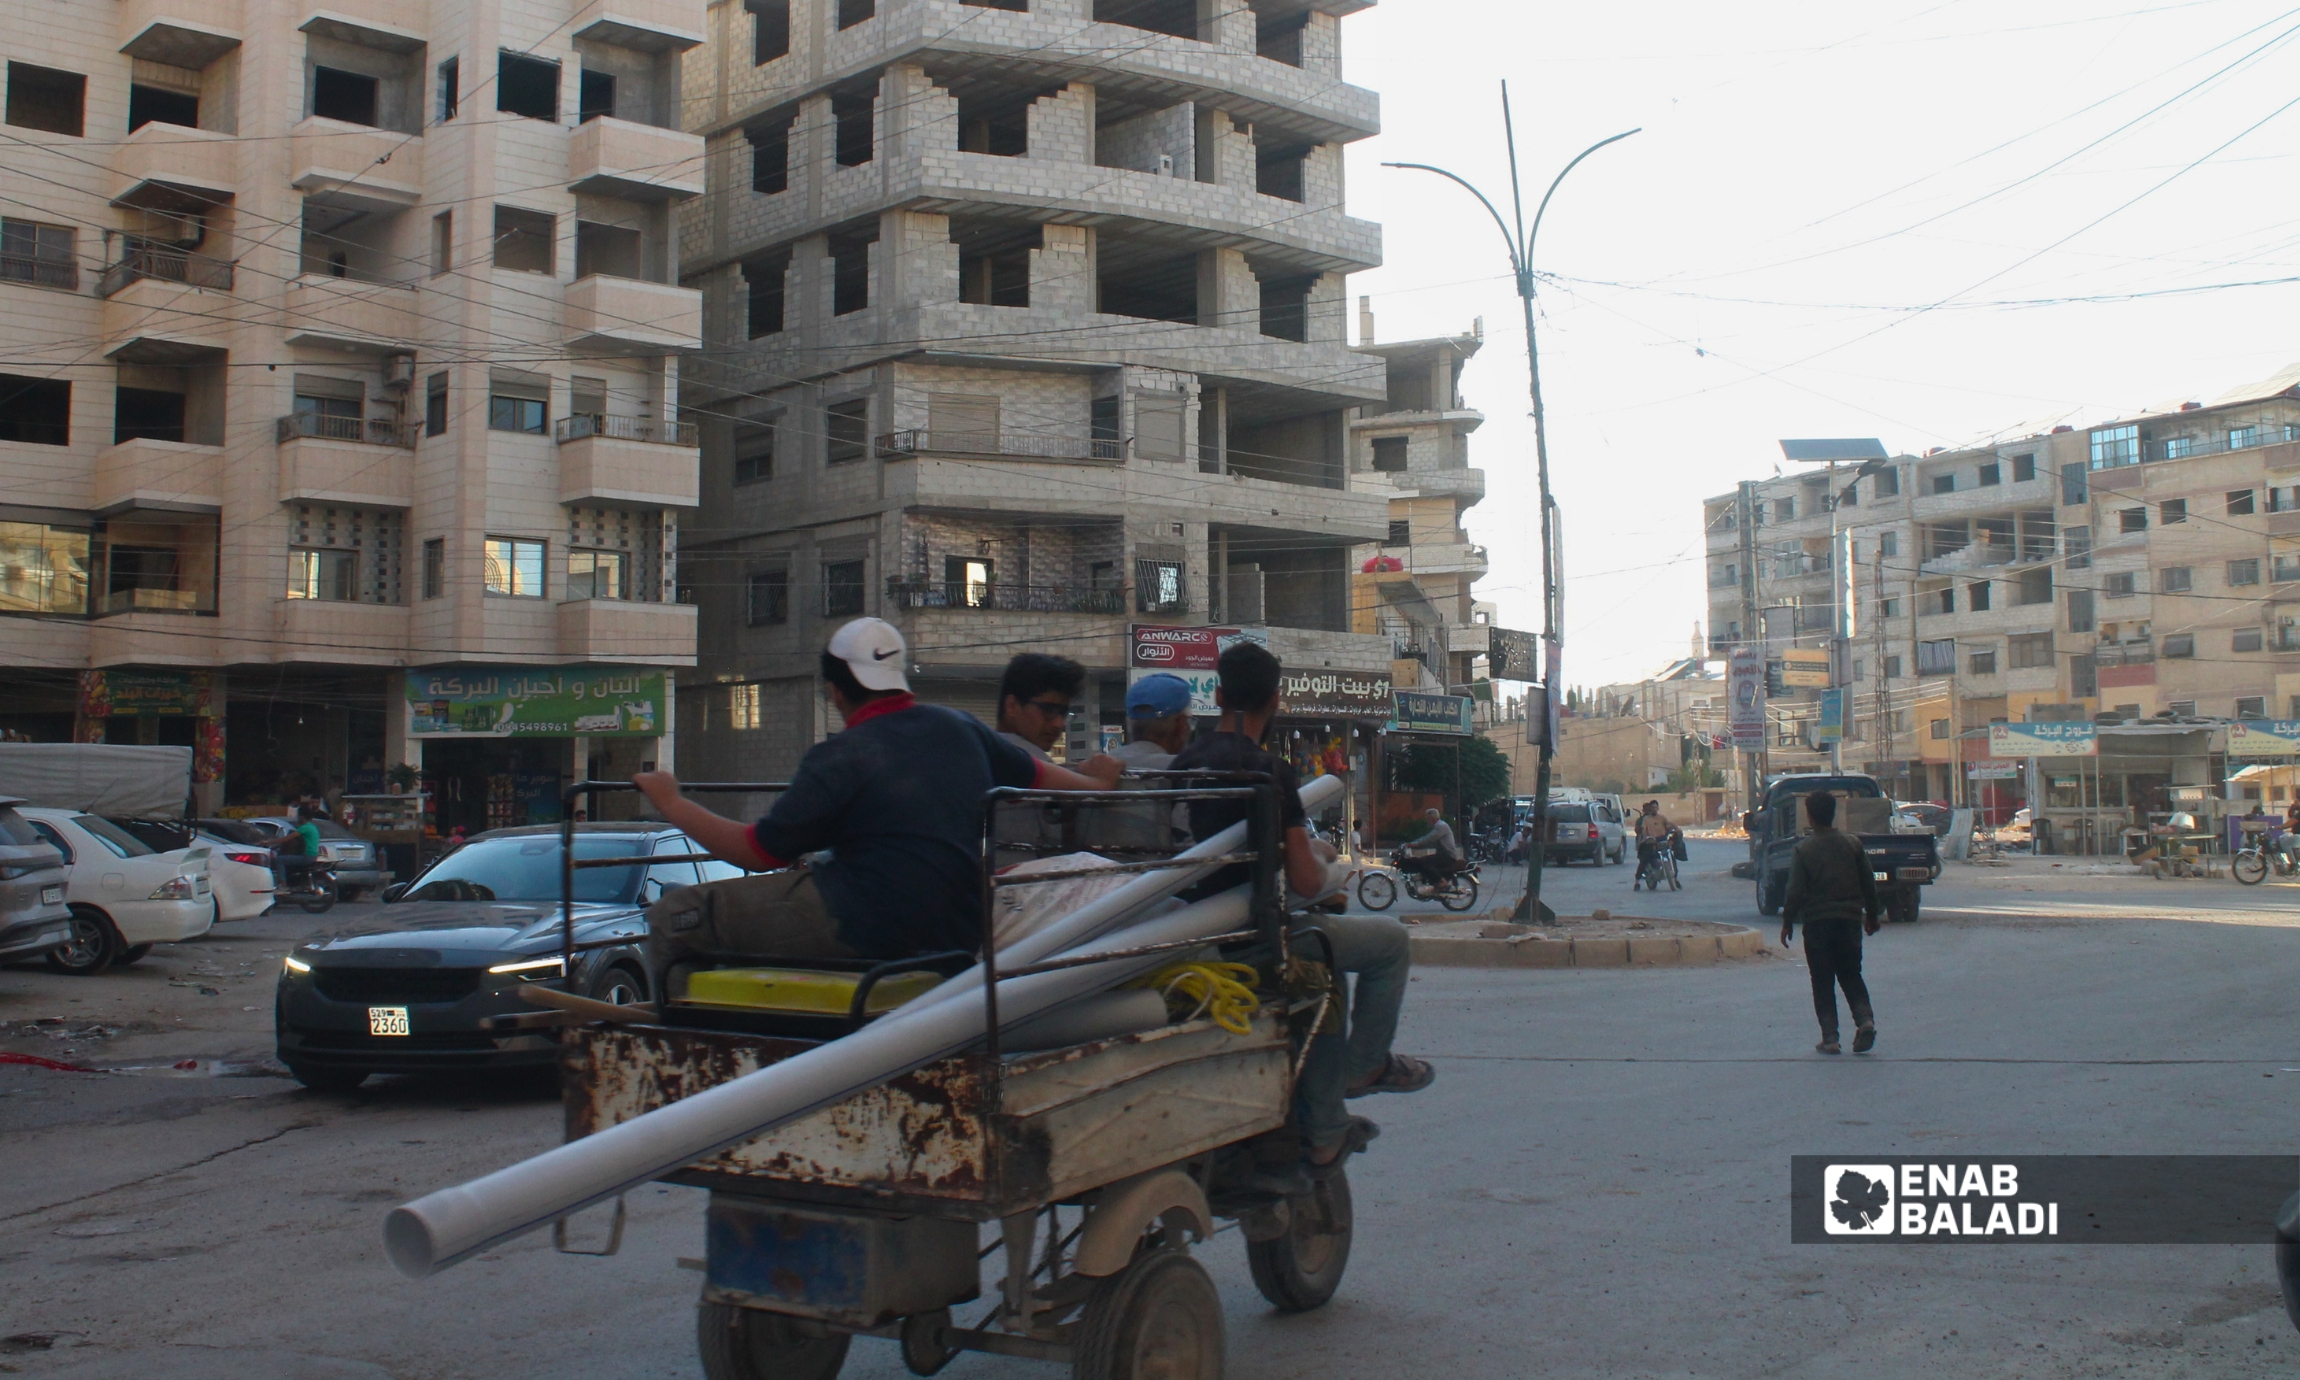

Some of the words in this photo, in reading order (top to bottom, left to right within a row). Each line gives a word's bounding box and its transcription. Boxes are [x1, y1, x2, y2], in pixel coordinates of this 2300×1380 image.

[428, 676, 499, 700] البركة
[571, 681, 585, 699] و
[593, 672, 640, 699] ألبان
[1286, 672, 1337, 699] التوفير
[1341, 677, 1370, 699] بيت
[2034, 724, 2062, 738] البركة
[2064, 724, 2093, 738] فروج
[2273, 722, 2300, 736] لبركة
[516, 788, 541, 800] البرك
[371, 1009, 386, 1018] 529
[373, 1018, 406, 1033] 2360
